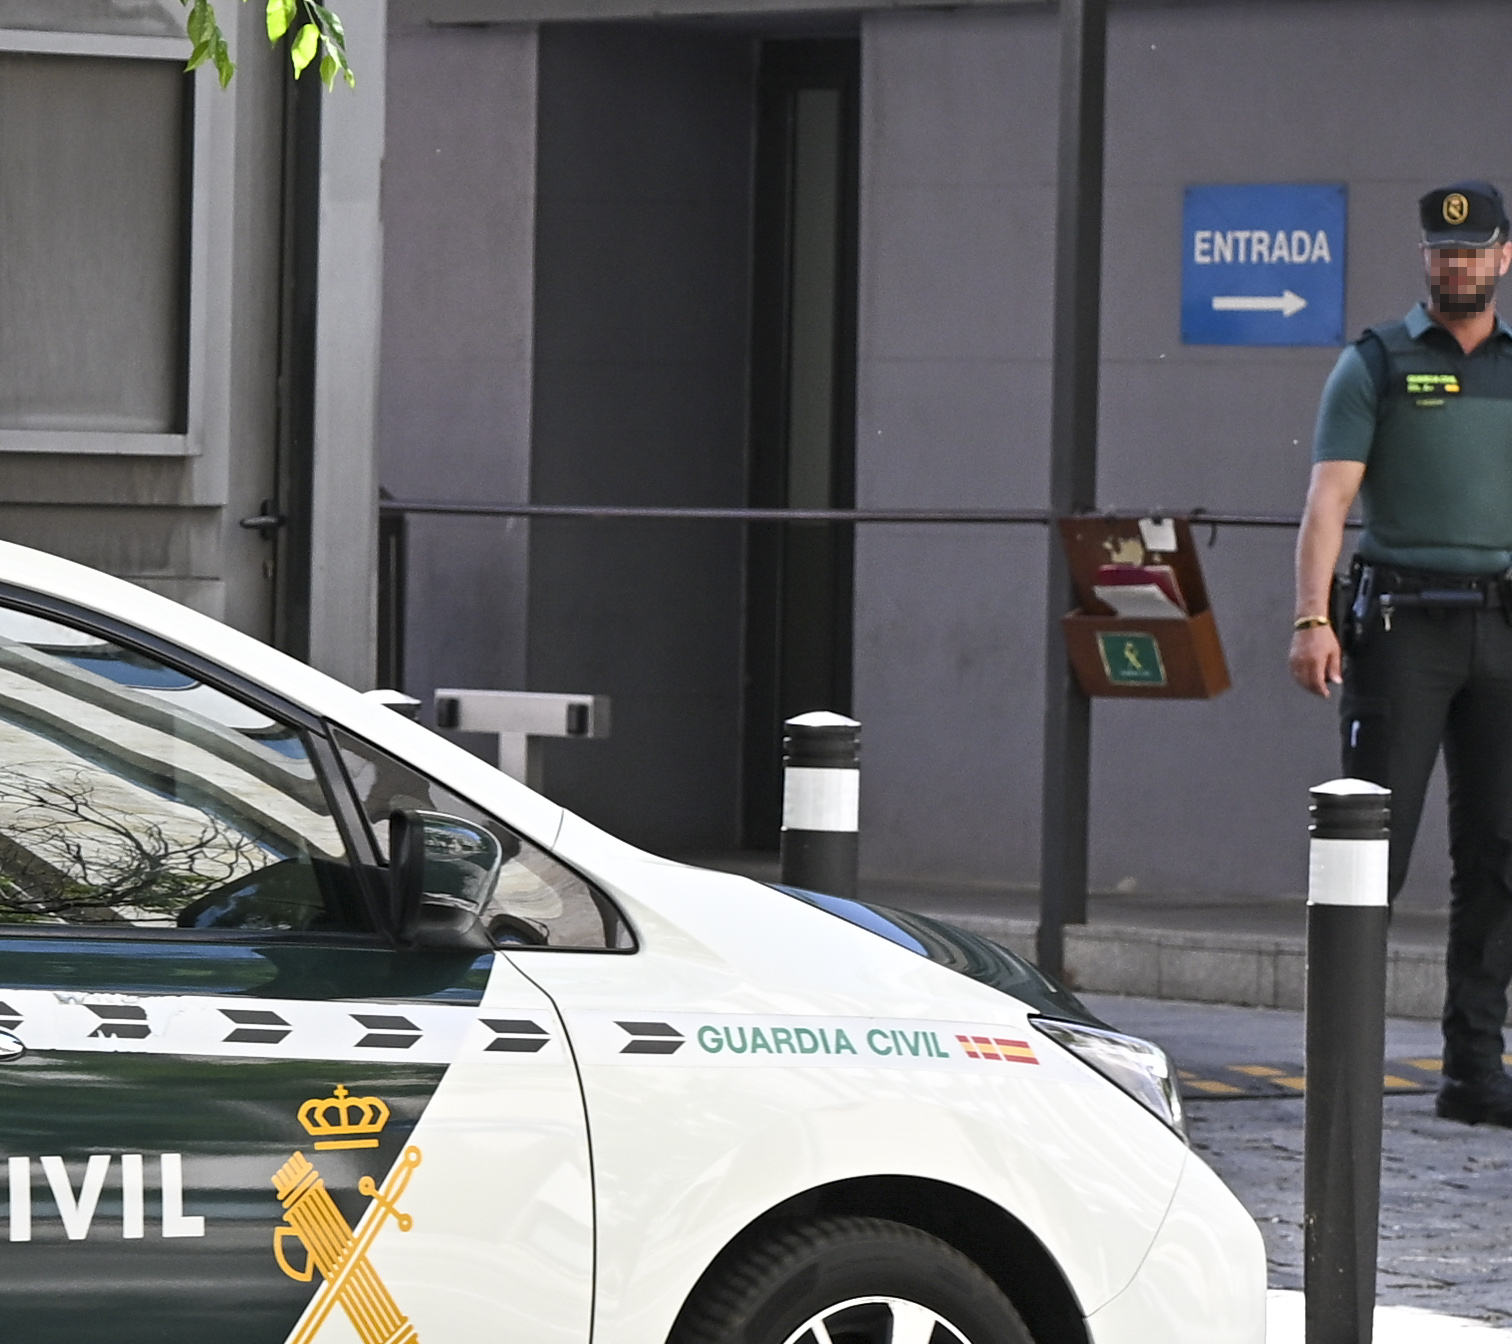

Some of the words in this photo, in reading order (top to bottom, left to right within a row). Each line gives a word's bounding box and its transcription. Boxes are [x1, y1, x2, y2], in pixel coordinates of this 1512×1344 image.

[1192, 227, 1332, 268] ENTRADA
[697, 1024, 857, 1056] GUARDIA
[866, 1029, 950, 1059] CIVIL
